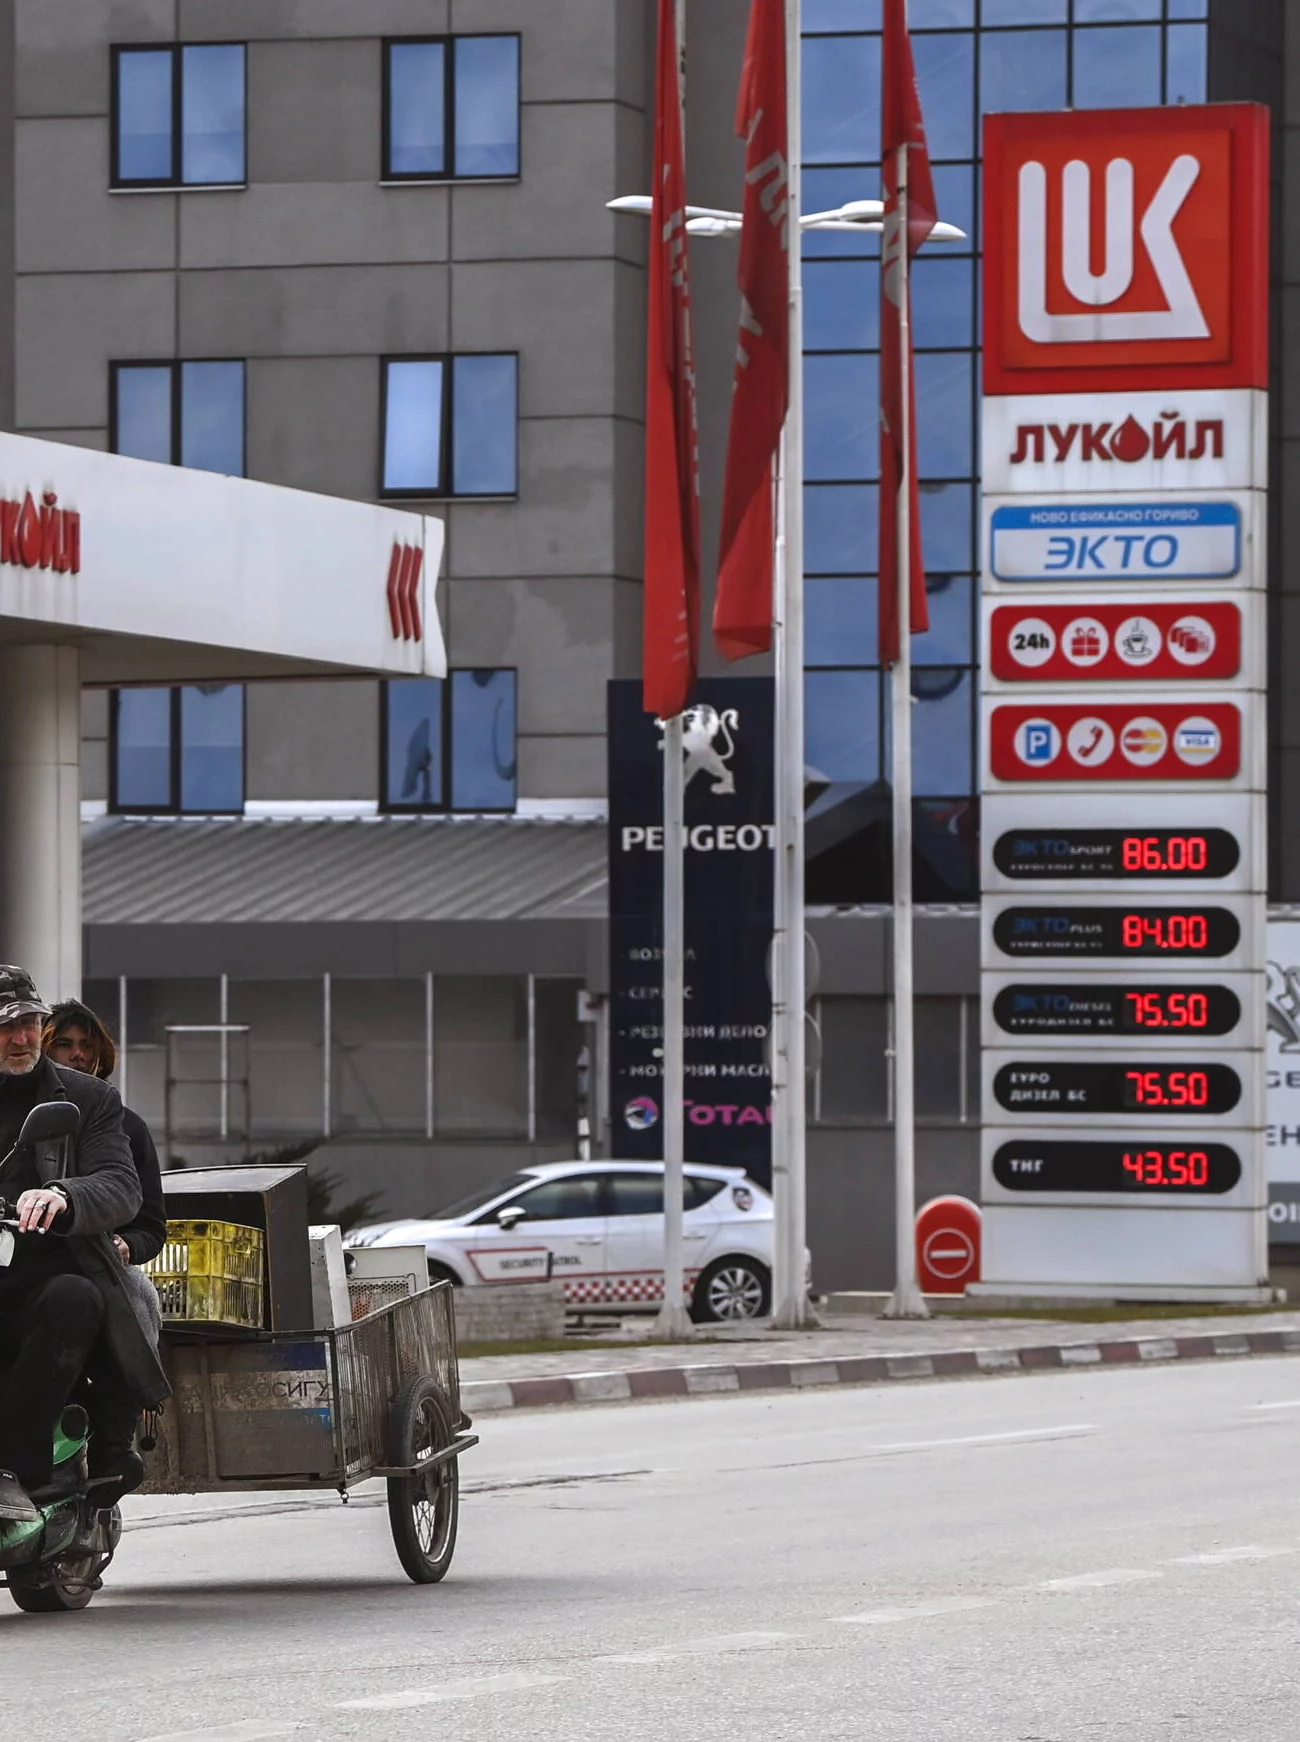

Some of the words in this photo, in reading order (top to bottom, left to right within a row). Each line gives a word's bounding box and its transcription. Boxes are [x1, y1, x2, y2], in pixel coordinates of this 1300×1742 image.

[1009, 411, 1224, 464] ЛУКОЙЛ
[1030, 511, 1068, 524] НОВО
[1145, 508, 1200, 522] ГОРИВО
[1043, 533, 1180, 571] ЭКТО
[1013, 632, 1050, 652] 24h
[1030, 730, 1047, 756] P
[621, 824, 777, 852] PEGEOT
[1122, 836, 1207, 871] 86.00
[1122, 914, 1207, 949] 84.00
[1125, 993, 1208, 1028] 75.50
[1125, 1071, 1209, 1106] 75.50
[1122, 1150, 1209, 1186] 43.50
